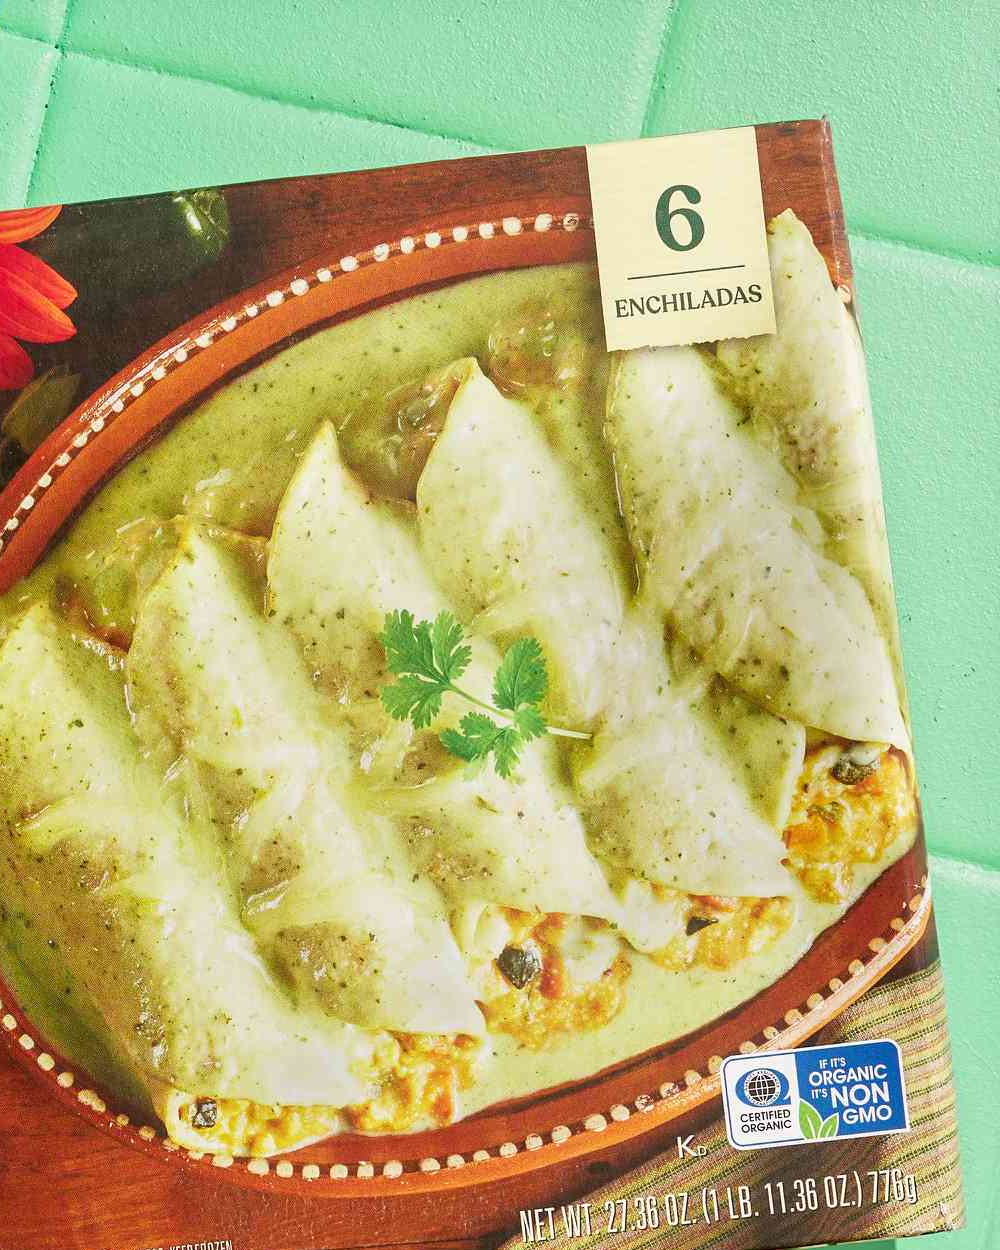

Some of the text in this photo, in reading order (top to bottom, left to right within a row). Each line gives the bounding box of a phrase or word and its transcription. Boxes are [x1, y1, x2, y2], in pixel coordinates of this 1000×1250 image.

[655, 184, 706, 252] 6
[614, 283, 763, 318] ENCHILADAS
[819, 1056, 847, 1069] IF IT'S
[808, 1063, 888, 1086] ORGANIC
[811, 1081, 891, 1109] IT'S NON
[740, 1108, 791, 1123] CERTIFIED
[843, 1104, 893, 1125] GMO
[741, 1119, 792, 1134] ORGANIC
[519, 1166, 919, 1244] NET WT. 27.36 OZ. (1 LB. 11.36 OZ.) 776g
